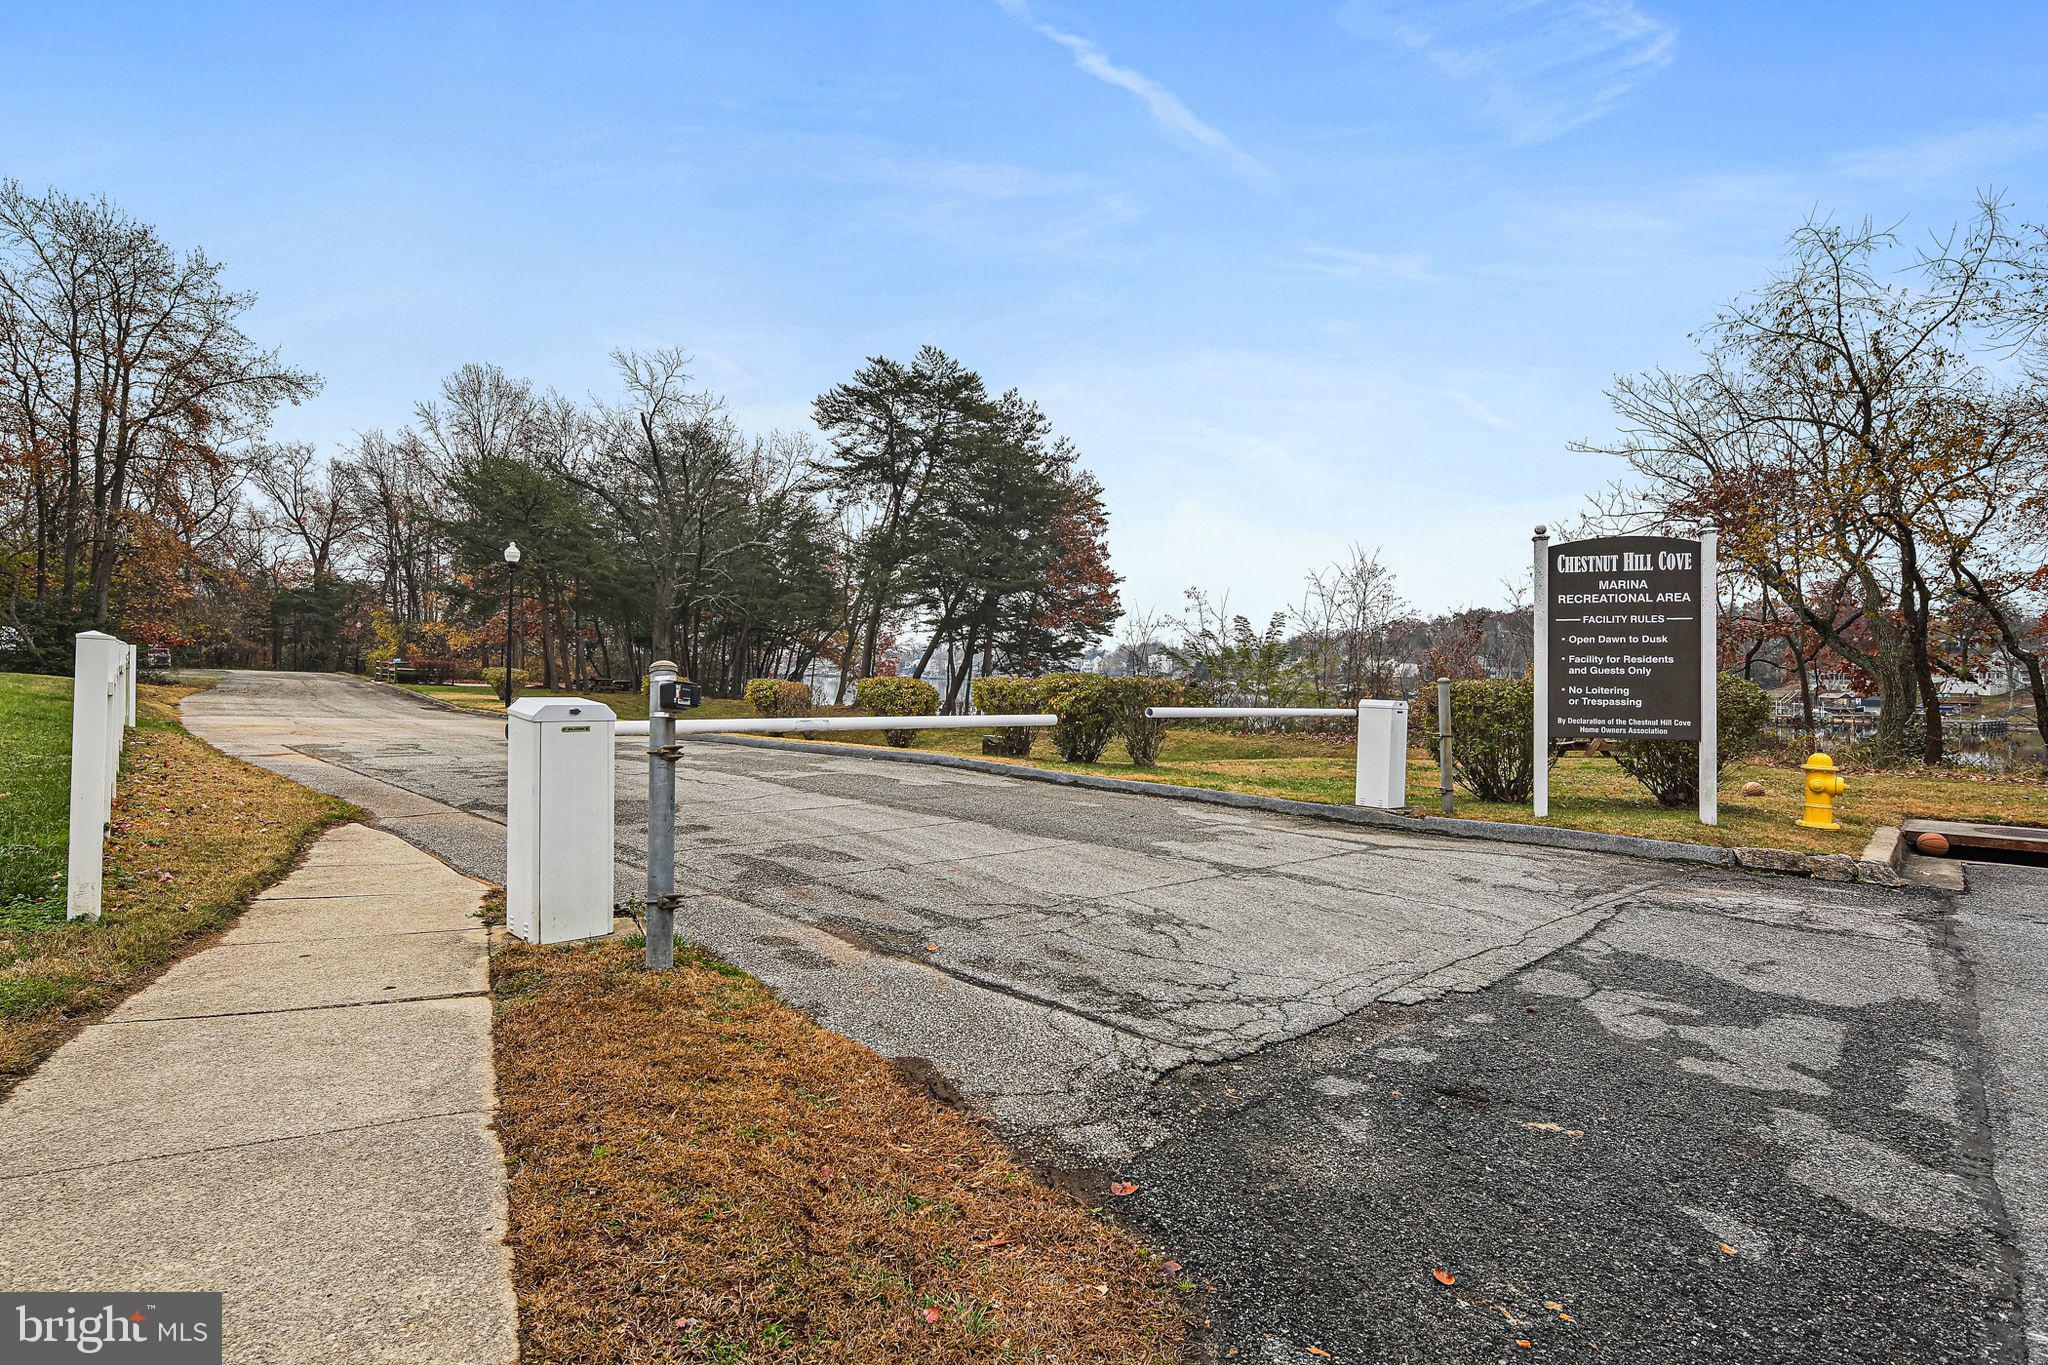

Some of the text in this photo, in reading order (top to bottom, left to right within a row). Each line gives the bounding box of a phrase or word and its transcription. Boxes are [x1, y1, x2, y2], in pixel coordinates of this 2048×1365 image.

[1599, 580, 1648, 589] MARINA
[1558, 593, 1691, 604] RECREATIONAL AREA
[1583, 615, 1665, 624] FACILITY RULES
[1568, 635, 1595, 645] Open
[1598, 635, 1626, 643] Dawn
[1642, 635, 1668, 643] Dusk
[1568, 655, 1674, 665] Facility for Residents
[1628, 667, 1652, 676] Only
[1568, 686, 1630, 696] No Loitering
[1582, 698, 1642, 708] Trespassing
